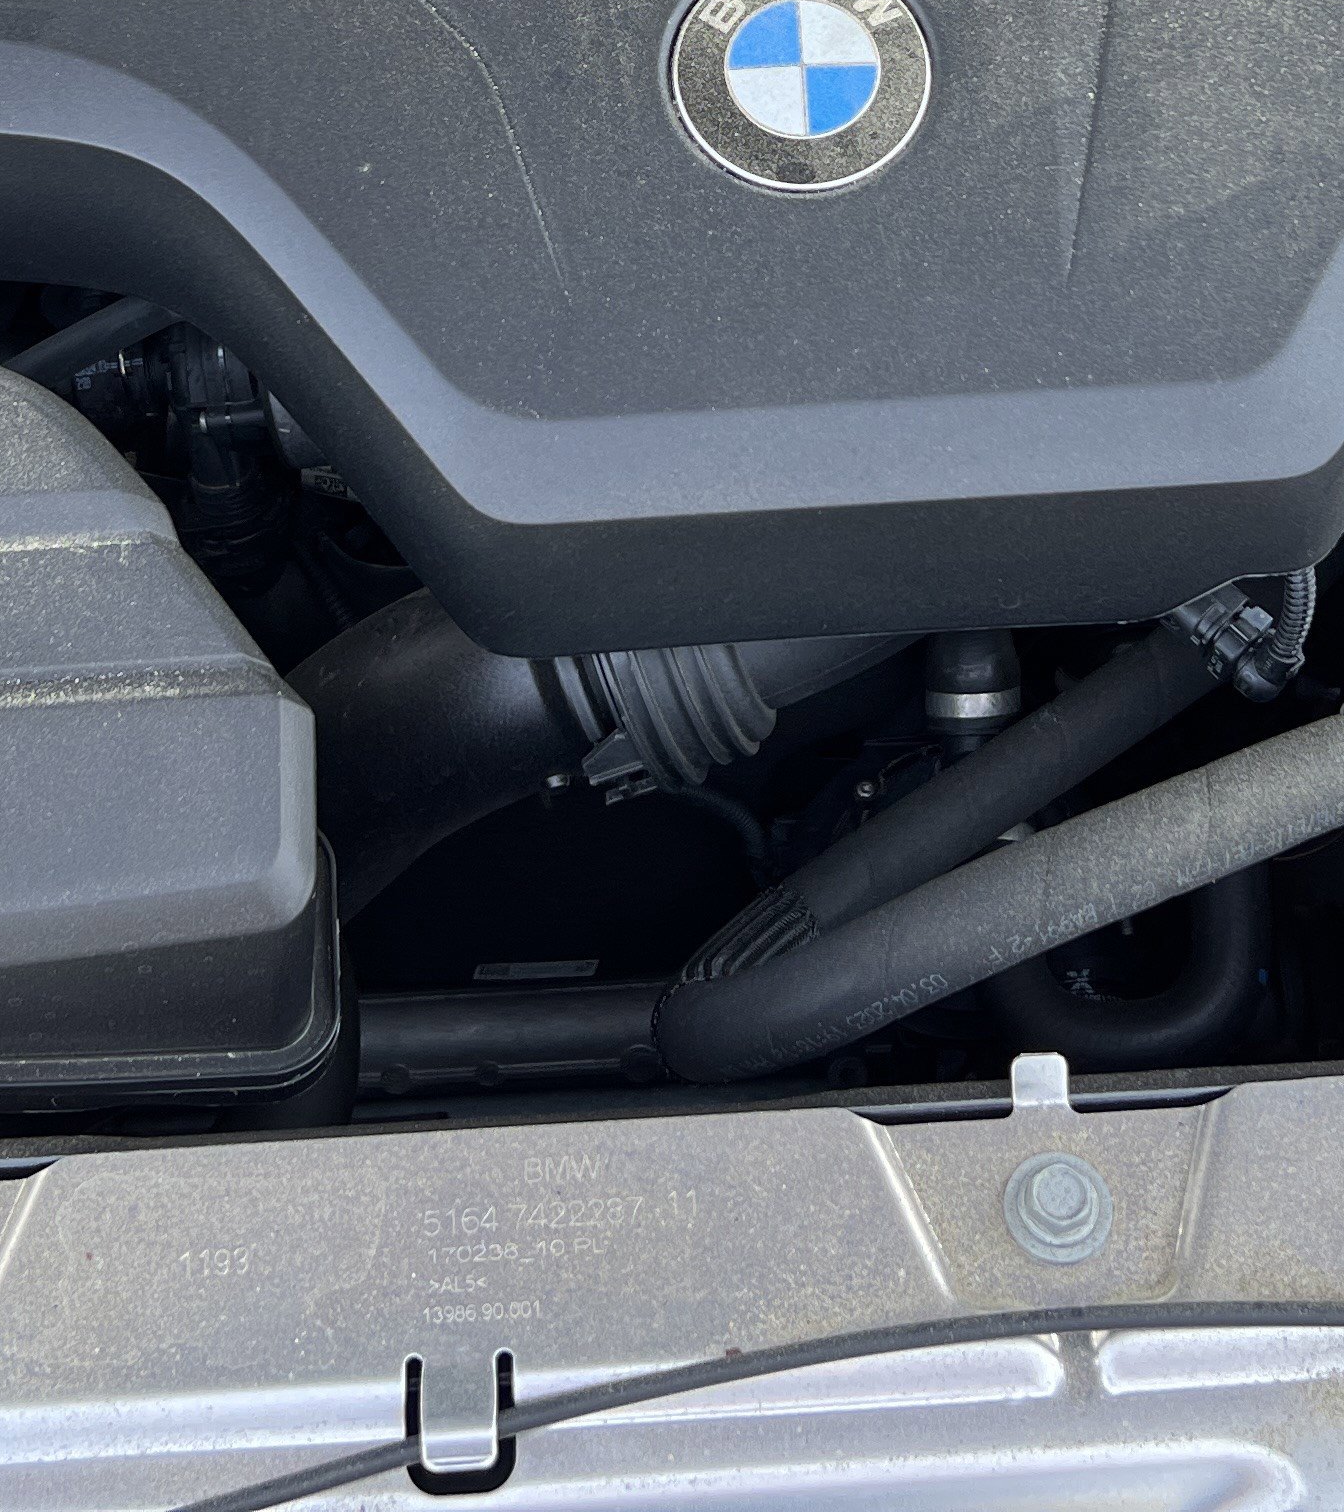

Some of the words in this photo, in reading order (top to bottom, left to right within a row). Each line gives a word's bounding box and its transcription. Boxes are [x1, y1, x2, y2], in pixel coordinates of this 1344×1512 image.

[524, 1153, 602, 1183] BMW
[422, 1205, 499, 1237] 5164
[178, 1246, 250, 1279] 1193
